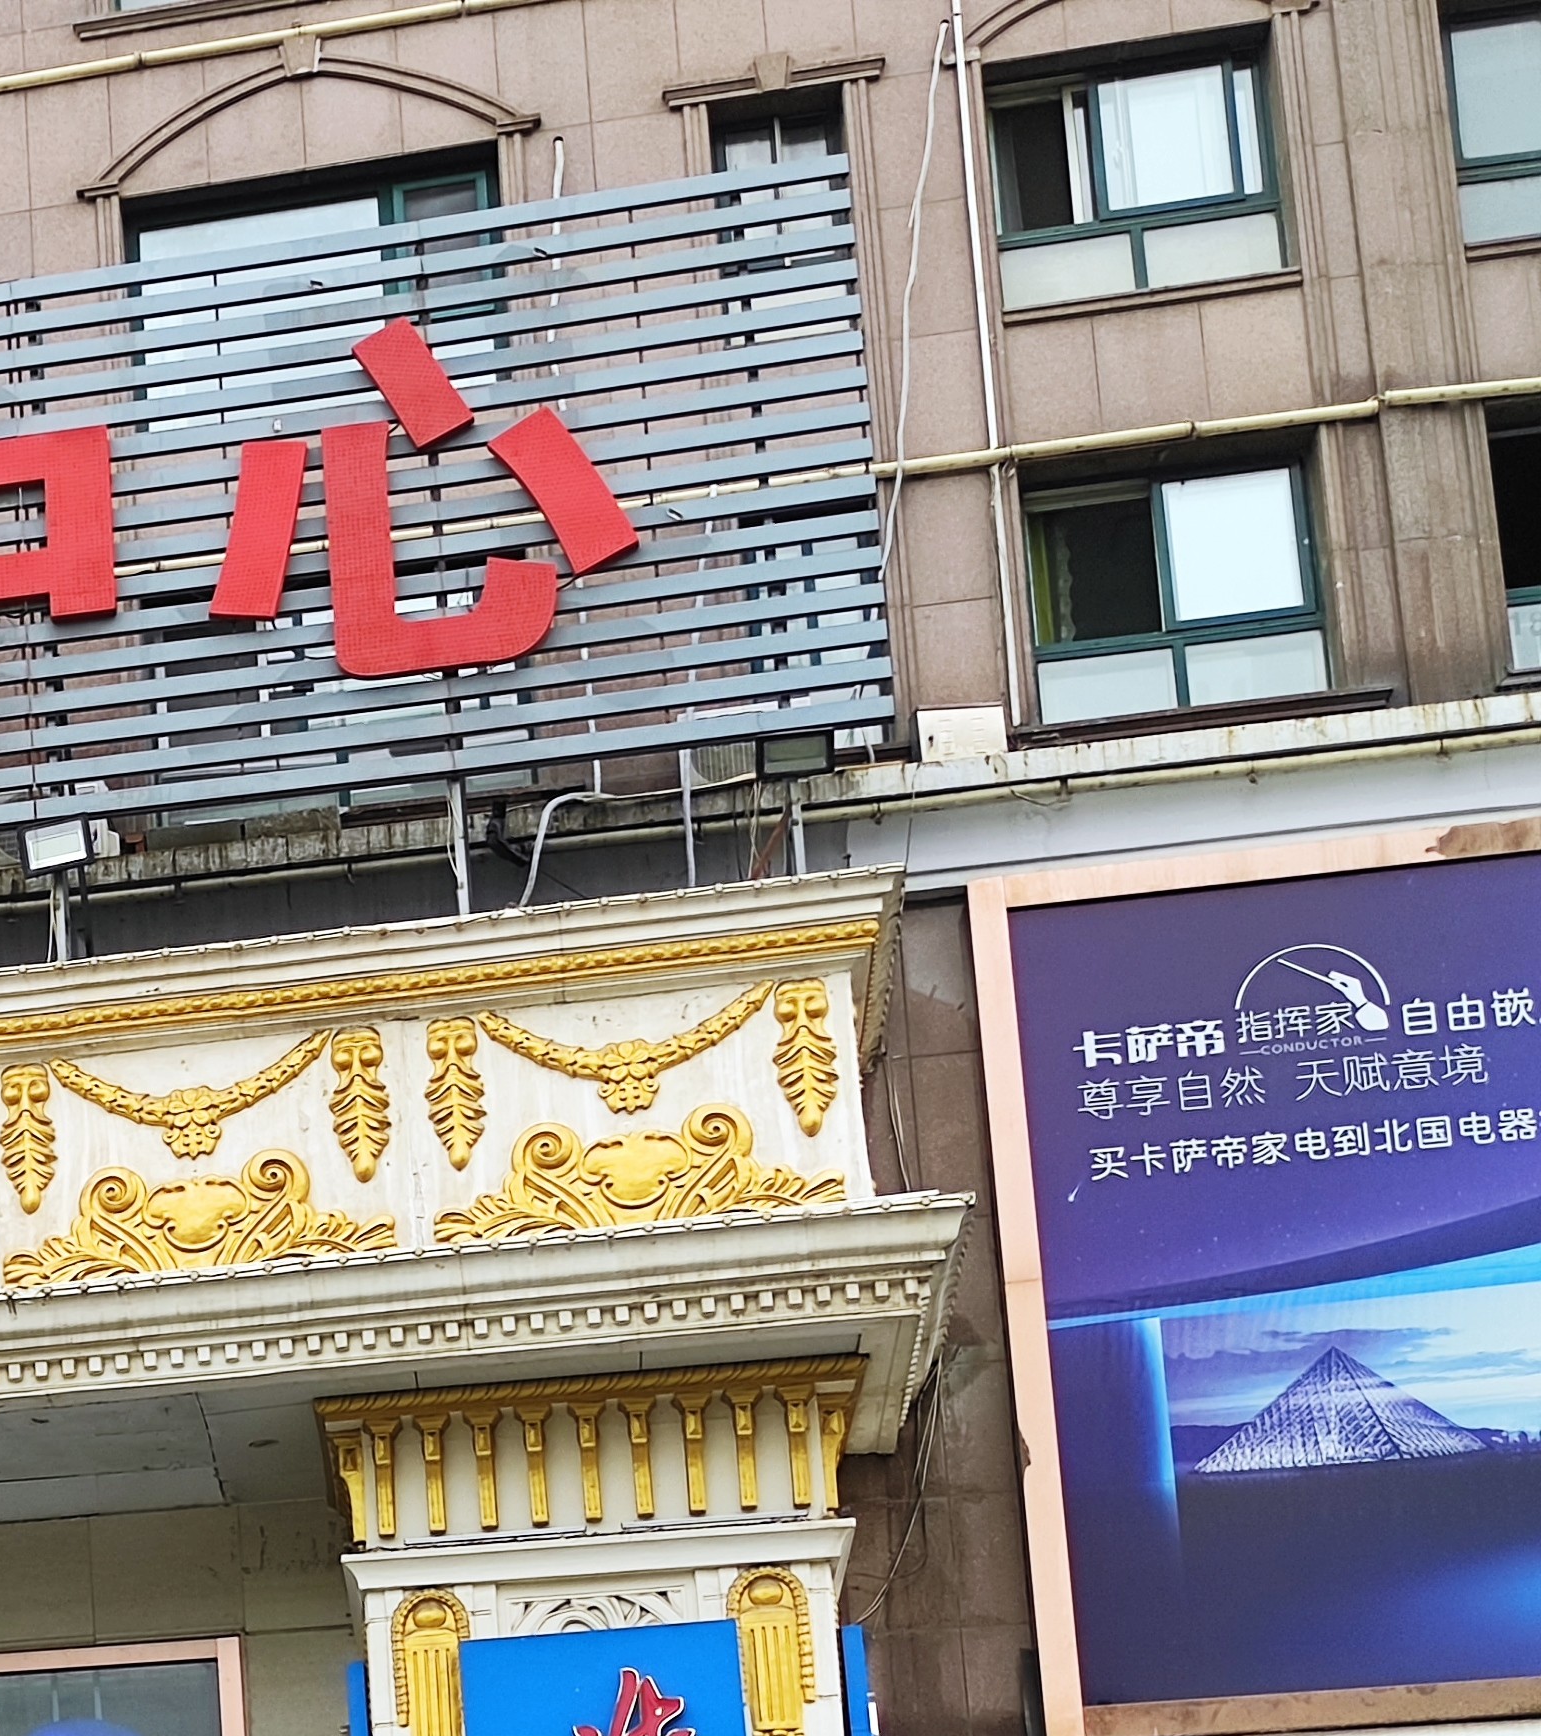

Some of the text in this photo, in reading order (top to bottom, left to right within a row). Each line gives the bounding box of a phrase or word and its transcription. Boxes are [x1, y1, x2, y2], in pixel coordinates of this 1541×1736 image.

[1072, 988, 1541, 1068] 卡萨帝 指挥家 自由嵌
[1260, 1035, 1364, 1056] CONDUCTOR
[1077, 1044, 1489, 1122] 尊享自然 天赋意境
[1090, 1107, 1541, 1183] 买卡萨帝家电到北国电器
